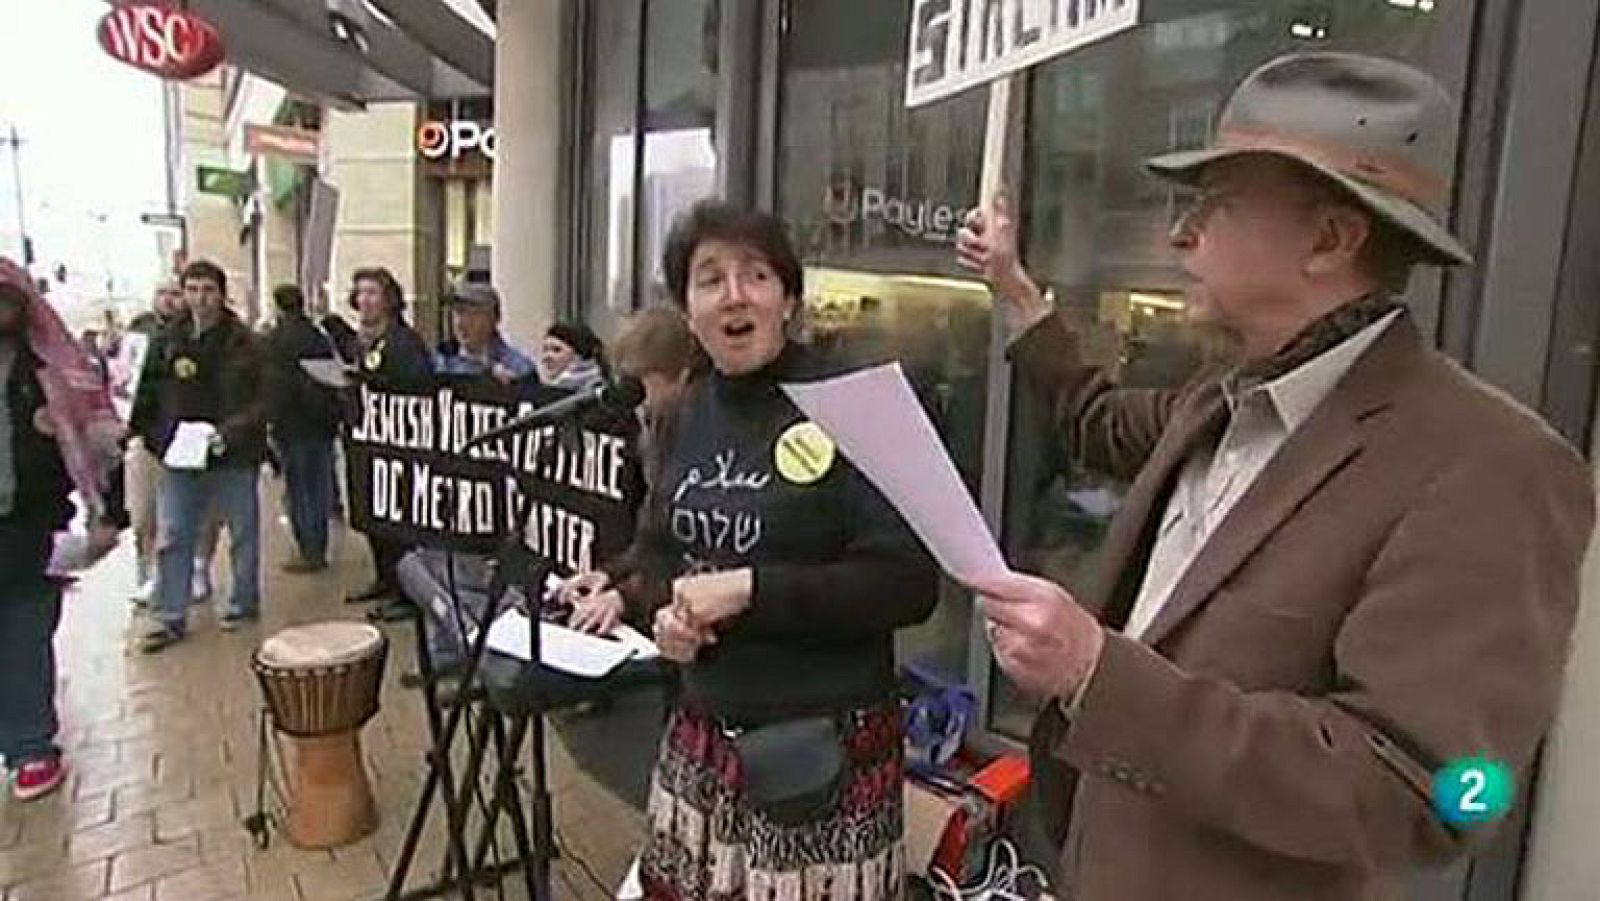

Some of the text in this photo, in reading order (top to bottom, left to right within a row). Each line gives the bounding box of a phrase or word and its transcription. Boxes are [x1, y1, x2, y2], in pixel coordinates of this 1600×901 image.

[351, 383, 434, 450] JEWISH
[372, 457, 403, 522] DC
[674, 448, 770, 502] سلام
[672, 507, 761, 553] שלום
